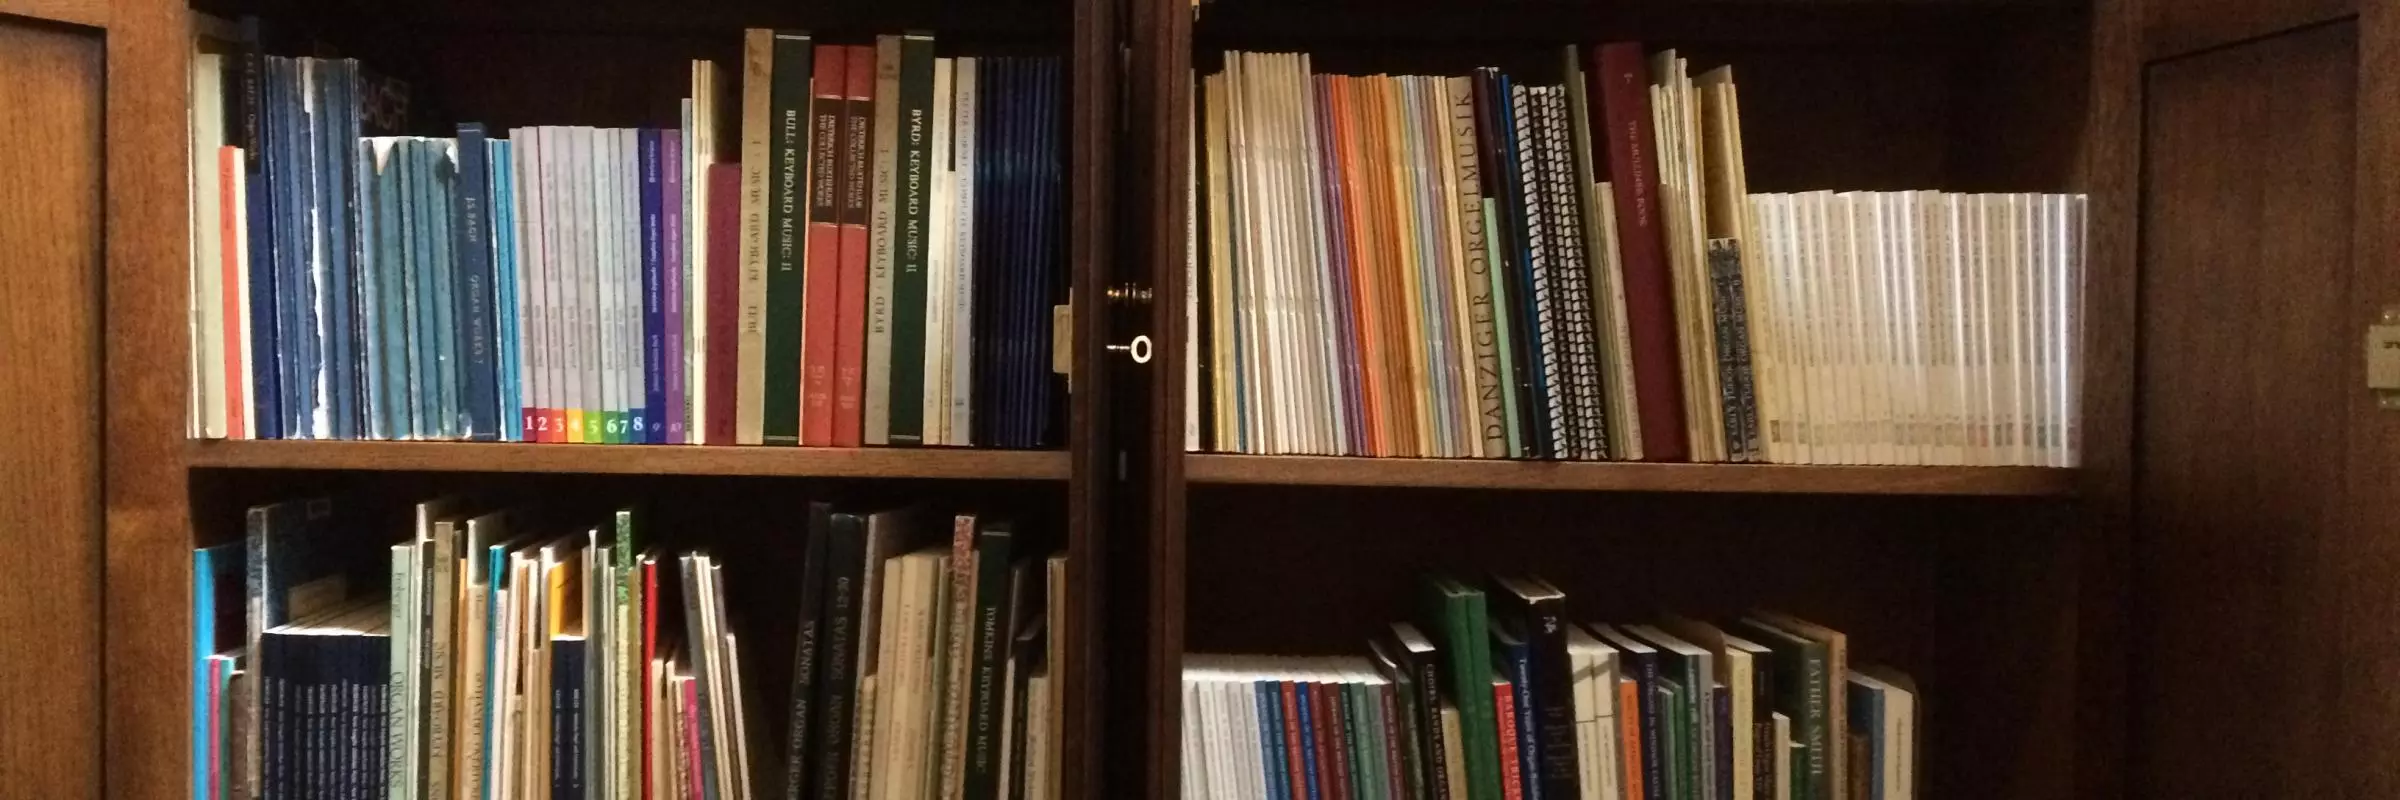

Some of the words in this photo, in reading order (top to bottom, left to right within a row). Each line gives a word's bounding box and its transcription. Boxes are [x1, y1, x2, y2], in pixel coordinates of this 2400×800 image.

[784, 110, 797, 144] BULL:
[819, 114, 827, 130] THE
[849, 116, 858, 130] THE
[911, 109, 923, 145] BYRD:
[750, 166, 761, 205] MUSIC
[783, 149, 796, 213] KEYBOARD
[815, 179, 825, 207] WORKS
[878, 168, 889, 203] MUSIC
[908, 149, 921, 215] KEYBOARD
[1455, 90, 1487, 275] ORGELMUSIK
[748, 213, 760, 281] KEYBOARD
[781, 217, 793, 259] MUSIC:
[875, 211, 888, 279] KEYBOARD
[907, 219, 919, 260] MUSIC:
[874, 296, 885, 333] BYRD
[1473, 291, 1504, 441] DANZIGER
[526, 416, 534, 430] 1
[538, 417, 548, 431] 2
[555, 418, 563, 432] 3
[588, 420, 597, 433] 5
[607, 419, 617, 433] 6
[620, 420, 628, 434] 7
[633, 417, 643, 431] 8
[798, 620, 815, 686] SONATAS
[830, 616, 848, 681] SONATAS
[391, 671, 405, 728] ORGAN
[979, 666, 994, 732] KEYBOARD
[1808, 658, 1822, 718] FATHER
[791, 699, 807, 749] ORGAN
[1504, 695, 1517, 753] BAROQUE
[390, 733, 404, 789] WORKS
[1809, 724, 1824, 776] SMITH
